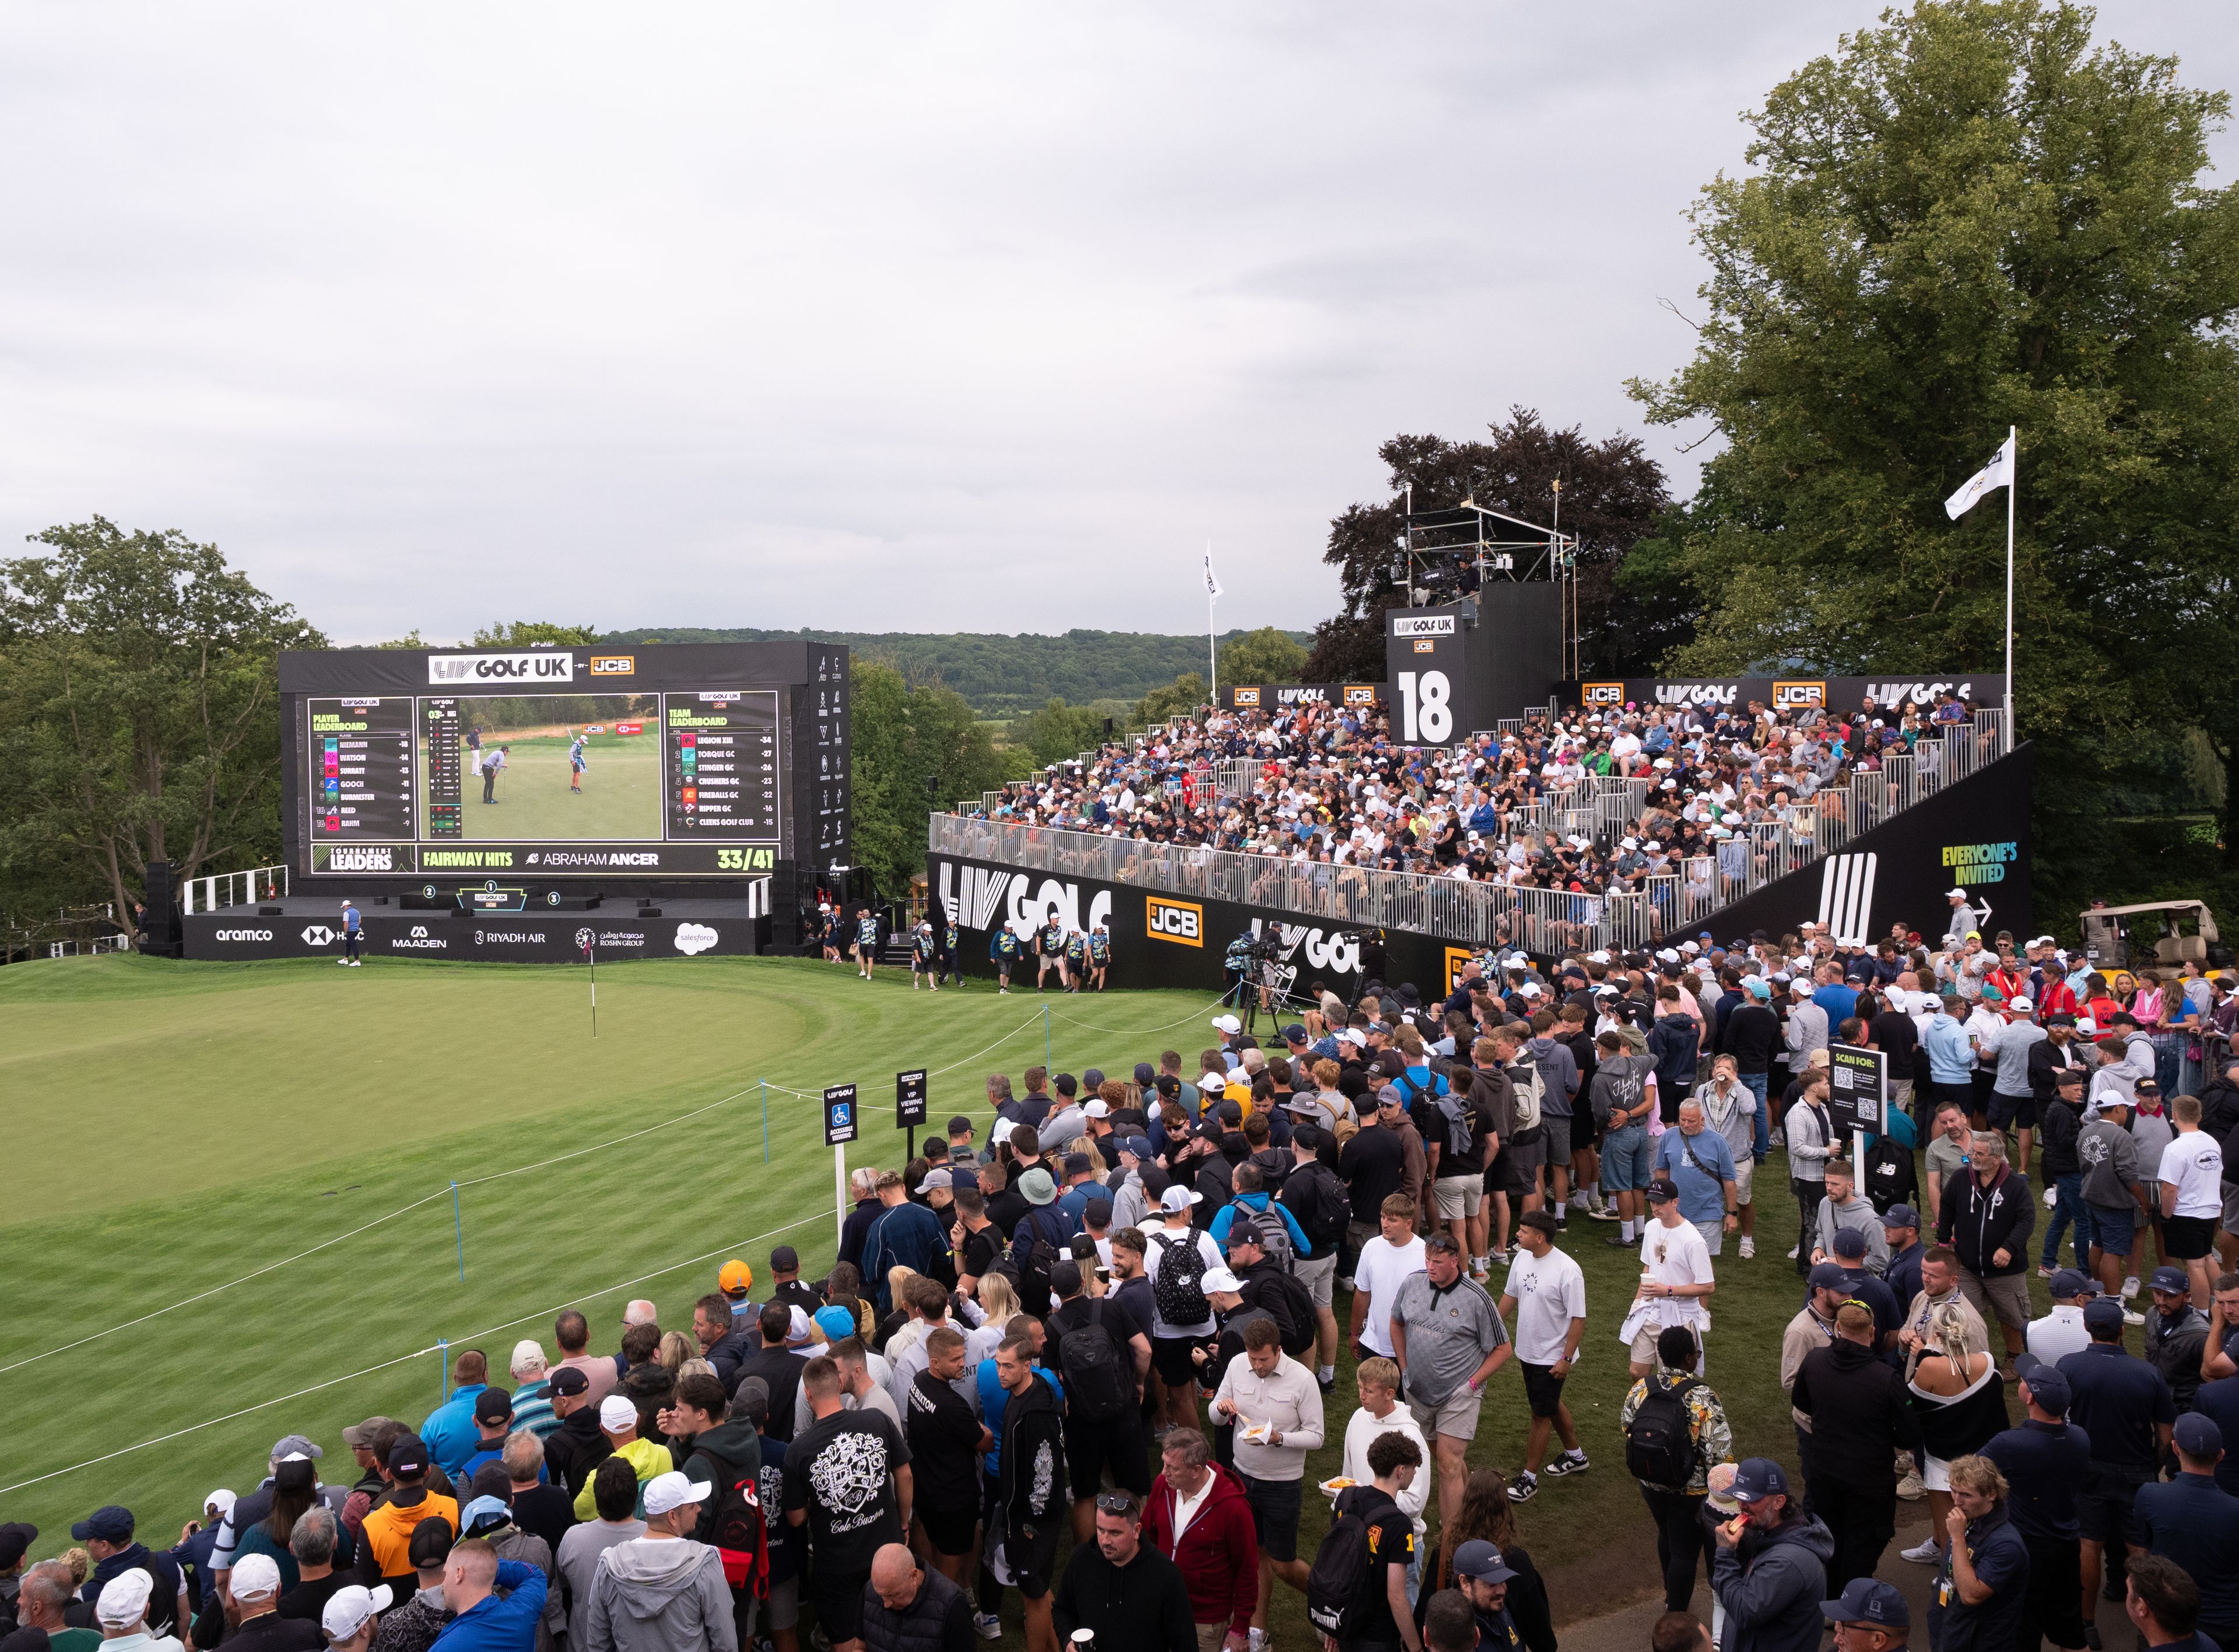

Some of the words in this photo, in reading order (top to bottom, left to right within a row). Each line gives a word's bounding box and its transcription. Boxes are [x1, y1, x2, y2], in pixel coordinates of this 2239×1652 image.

[1413, 620, 1435, 631] GOLF
[1438, 620, 1451, 630] UK
[476, 659, 528, 677] GOLF
[535, 658, 567, 676] UK
[594, 660, 631, 672] JCB
[1237, 691, 1258, 702] JCB
[1347, 690, 1371, 702] JCB
[1586, 688, 1620, 702] JCB
[1690, 686, 1737, 704] GOLF
[1778, 687, 1820, 702] JCB
[669, 709, 691, 718] TEAM
[1398, 671, 1452, 743] 18
[428, 711, 440, 719] 03
[669, 718, 728, 726] LEADERBOARD
[313, 722, 368, 731] LEADERBOARD
[423, 852, 483, 867] FAIRWAY
[486, 852, 513, 866] HITS
[543, 853, 607, 866] ABRAHAM
[609, 853, 659, 866] ANCER
[718, 849, 773, 870] 33/41
[1942, 842, 2017, 867] EVERYONE'S
[331, 855, 392, 870] LEADERS
[1956, 863, 2005, 886] INVITED
[1008, 874, 1111, 948] GOLF
[1152, 906, 1198, 937] JCB
[216, 930, 273, 941] aramco
[487, 933, 525, 943] RIYADH
[528, 933, 545, 943] AIR
[619, 932, 644, 940] مجموعة
[681, 934, 714, 942] salesforce
[392, 939, 447, 948] MAADEN
[1836, 1053, 1855, 1064] SCAN
[1856, 1057, 1875, 1068] FOR:
[838, 1088, 854, 1096] GOLF
[901, 1098, 922, 1107] VIEWING
[830, 1125, 853, 1136] ACCESSIBLE
[831, 1131, 851, 1141] VIEWING
[2082, 1135, 2109, 1155] CHEVROLET
[1410, 1317, 1445, 1334] adidas
[915, 1387, 936, 1414] BUXTON
[831, 1519, 851, 1534] Cole
[1311, 1607, 1336, 1630] PUMA
